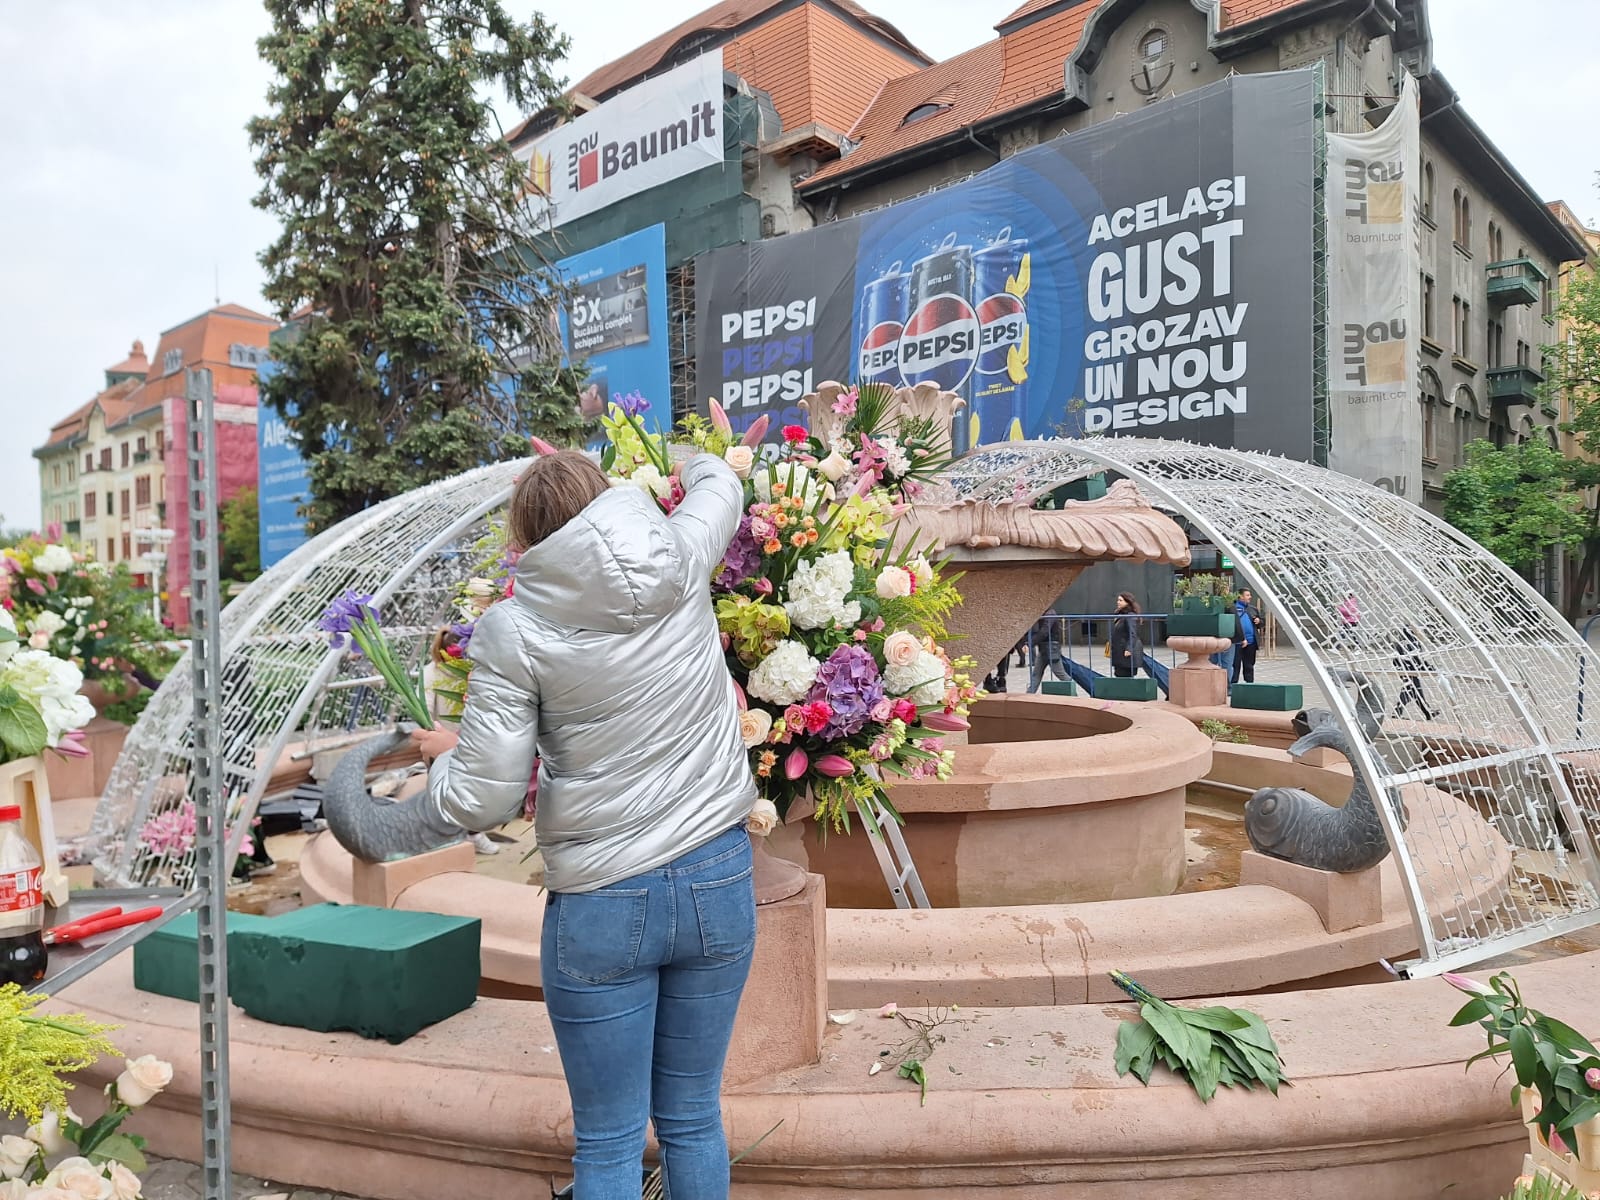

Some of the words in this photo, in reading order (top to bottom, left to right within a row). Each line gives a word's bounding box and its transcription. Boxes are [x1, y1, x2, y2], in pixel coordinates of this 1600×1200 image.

[602, 100, 716, 180] Baumit
[1087, 175, 1246, 246] ACELAȘI
[1088, 219, 1244, 322] GUST
[574, 335, 605, 350] echipate
[604, 313, 633, 330] complet
[722, 296, 817, 343] PEPSI
[981, 320, 1023, 346] EPSI
[1084, 302, 1249, 361] GROZAV
[722, 333, 815, 378] PEPSI
[903, 329, 975, 364] PEPSI
[722, 368, 813, 410] PEPSI
[1084, 362, 1124, 403] UN
[1137, 341, 1248, 395] NOU
[1085, 386, 1248, 433] DESIGN
